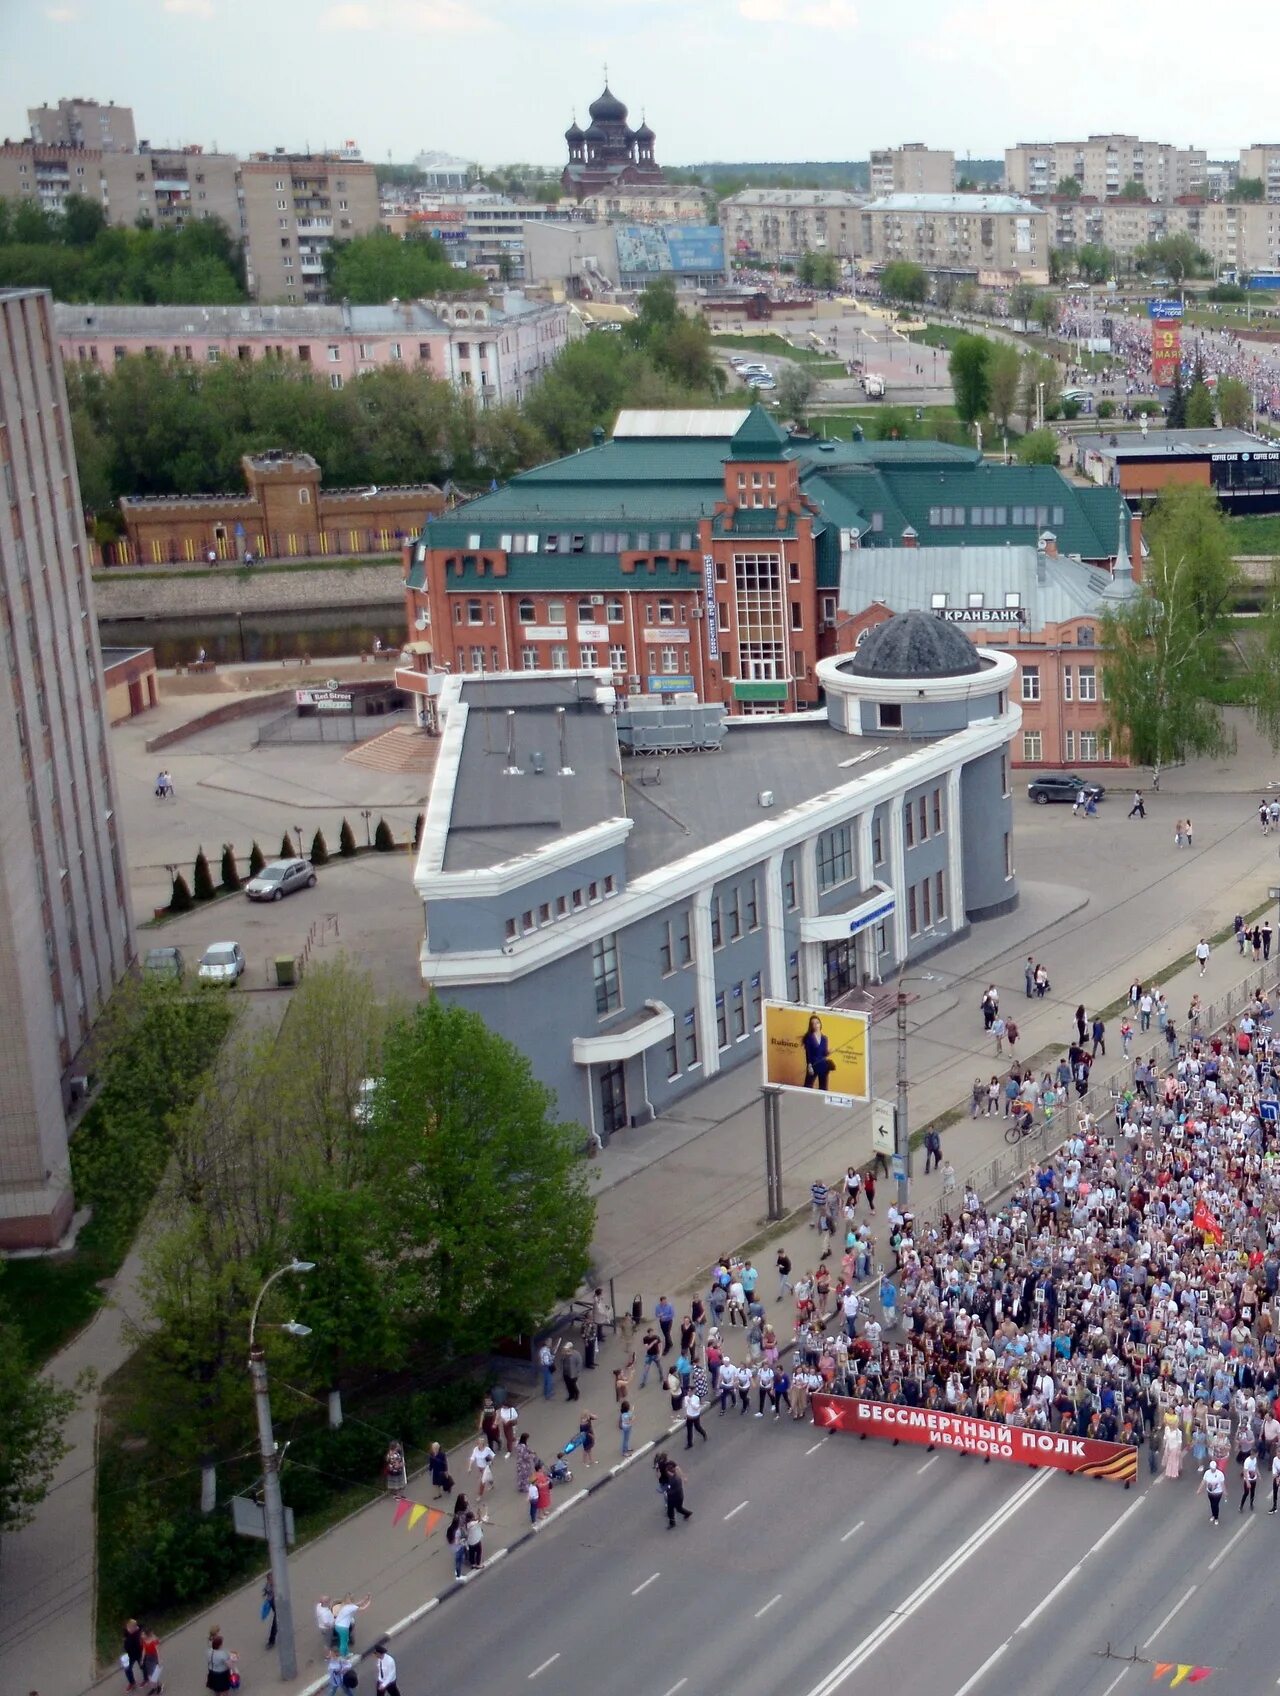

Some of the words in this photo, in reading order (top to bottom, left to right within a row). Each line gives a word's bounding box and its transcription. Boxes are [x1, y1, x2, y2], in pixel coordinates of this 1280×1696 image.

[1163, 332, 1173, 348] 9
[1268, 452, 1279, 460] CAKE
[945, 610, 1019, 621] КРАНБАНК
[858, 1403, 1012, 1443] БЕССМЕРТНЫЙ
[1022, 1432, 1086, 1456] ПОЛК
[930, 1430, 1013, 1457] ИВАНОВО
